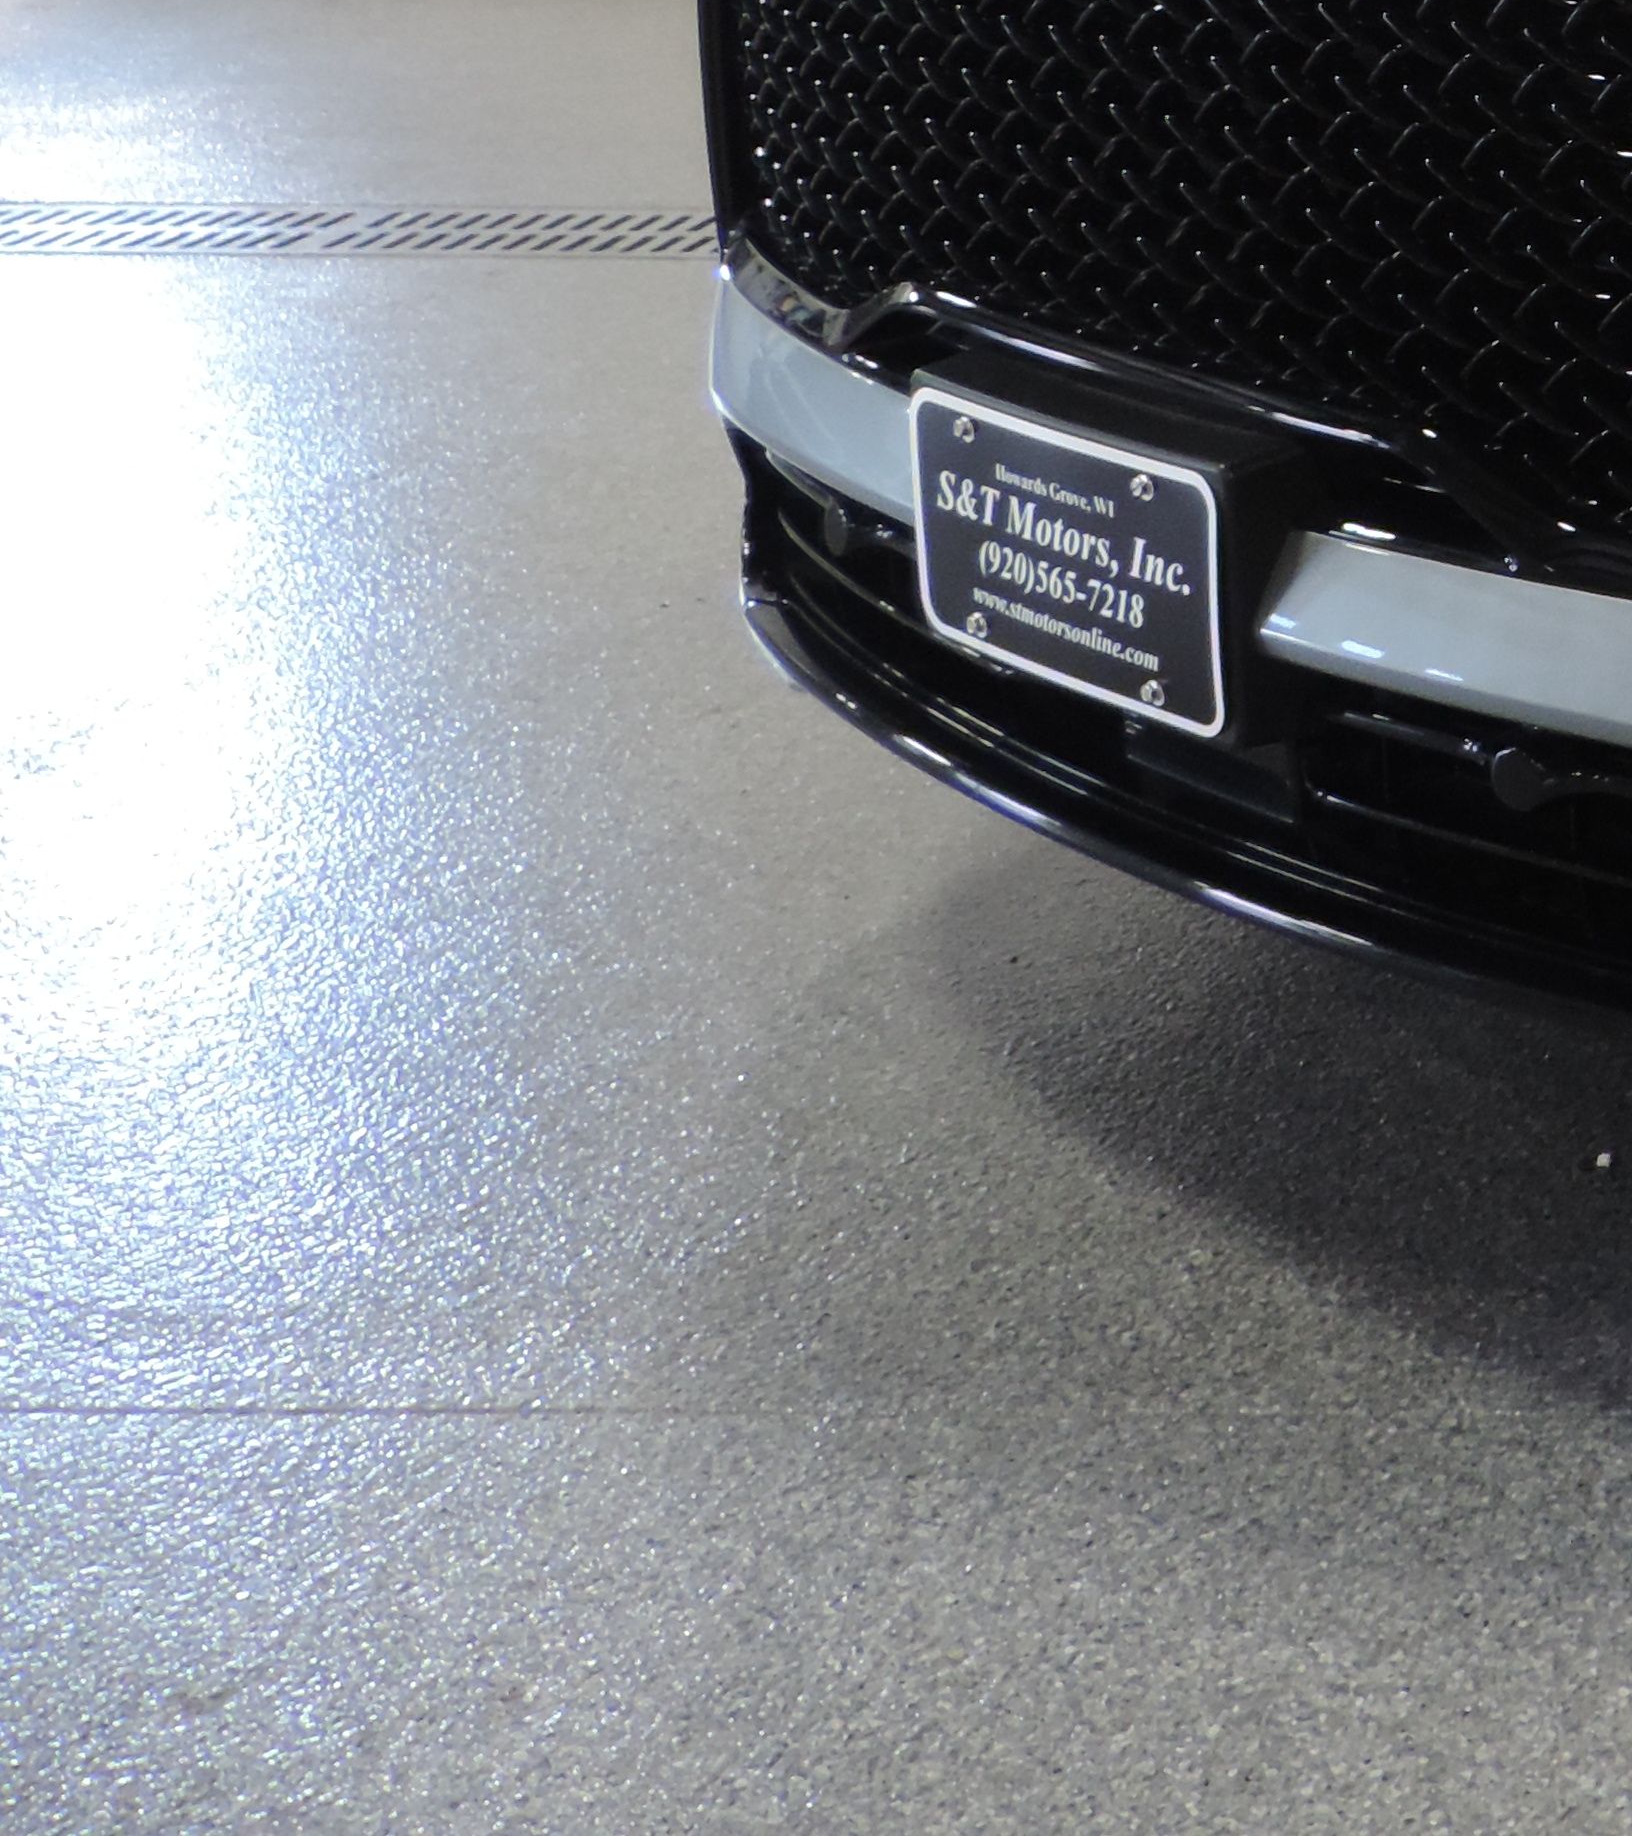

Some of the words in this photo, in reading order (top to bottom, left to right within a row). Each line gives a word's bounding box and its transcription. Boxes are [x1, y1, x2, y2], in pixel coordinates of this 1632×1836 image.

[937, 470, 1000, 526] S&T
[1006, 495, 1119, 578] Motors,
[1129, 537, 1190, 596] Inc.
[1049, 482, 1092, 512] Grove,
[1093, 495, 1115, 518] WI
[978, 540, 1144, 629] (920)565-7218
[972, 587, 1159, 672] www.stmotorsonline.com
